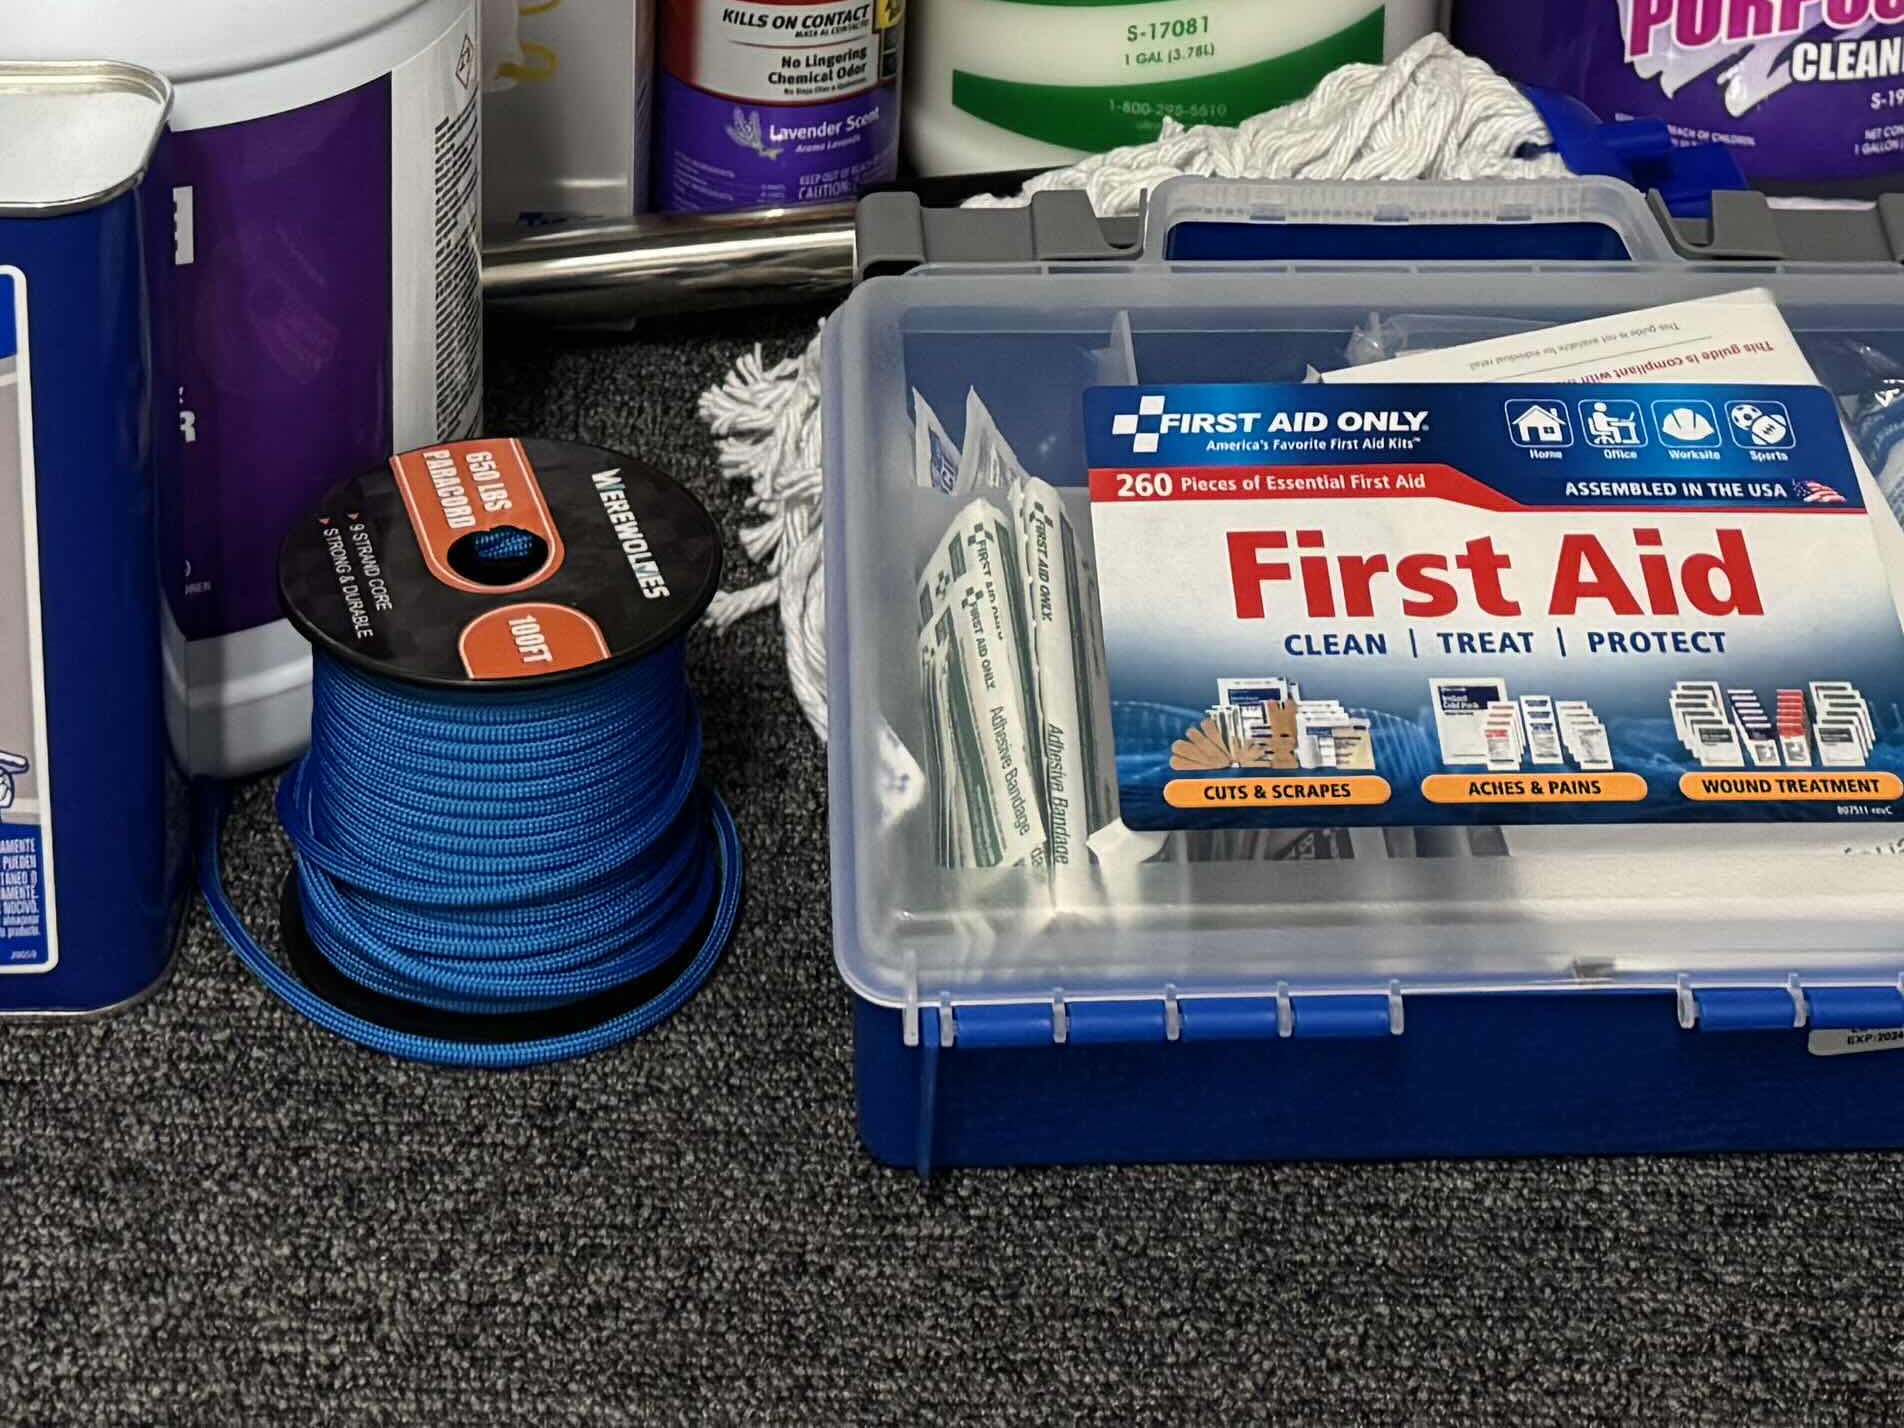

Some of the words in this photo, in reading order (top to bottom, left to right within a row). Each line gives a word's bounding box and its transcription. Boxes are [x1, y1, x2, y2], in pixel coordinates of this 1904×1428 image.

[722, 8, 769, 28] KILLS
[772, 14, 797, 30] ON
[801, 4, 871, 30] CONTACT
[1127, 15, 1211, 43] S-17081
[781, 56, 801, 69] No
[805, 46, 868, 68] Lingering
[768, 67, 834, 85] Chemical
[837, 61, 867, 79] Odor
[769, 119, 843, 142] Lavender
[846, 107, 880, 129] Scent
[1160, 412, 1262, 434] FIRST
[1267, 412, 1328, 432] AID
[1206, 439, 1269, 452] America's
[1273, 438, 1326, 452] Favorite
[1331, 438, 1360, 450] First
[1364, 437, 1384, 449] Aid
[465, 451, 501, 484] 650
[423, 449, 476, 529] PARACORD
[476, 479, 512, 514] LBS
[1116, 473, 1172, 497] 260
[1181, 476, 1236, 492] Pieces
[1242, 475, 1260, 491] of
[1267, 475, 1345, 490] Essential
[1351, 474, 1390, 490] First
[1395, 474, 1425, 489] Aid
[1566, 481, 1676, 498] ASSEMBLED
[1682, 482, 1702, 498] IN
[1707, 481, 1742, 497] THE
[1748, 481, 1787, 497] USA
[354, 522, 365, 531] 9
[592, 467, 671, 601] WEREWOLVES
[351, 530, 381, 585] STRAND
[322, 527, 351, 575] STRONG
[342, 583, 373, 639] DURABLE
[1226, 529, 1523, 620] First
[1548, 528, 1764, 617] Aid
[366, 581, 392, 612] CORE
[507, 614, 554, 664] 100FT
[1284, 633, 1387, 656] CLEAN
[1437, 631, 1534, 654] TREAT
[1587, 631, 1726, 654] PROTECT
[990, 706, 1013, 767] Adhesive
[1004, 767, 1030, 837] Bandage
[1204, 784, 1248, 800] CUTS
[1254, 785, 1266, 799] &
[1272, 783, 1351, 799] SCRAPES
[1468, 780, 1525, 796] ACHES
[1530, 781, 1543, 795] &
[1549, 780, 1602, 796] PAINS
[1703, 778, 1772, 794] WOUND
[1778, 778, 1880, 794] TREATMENT
